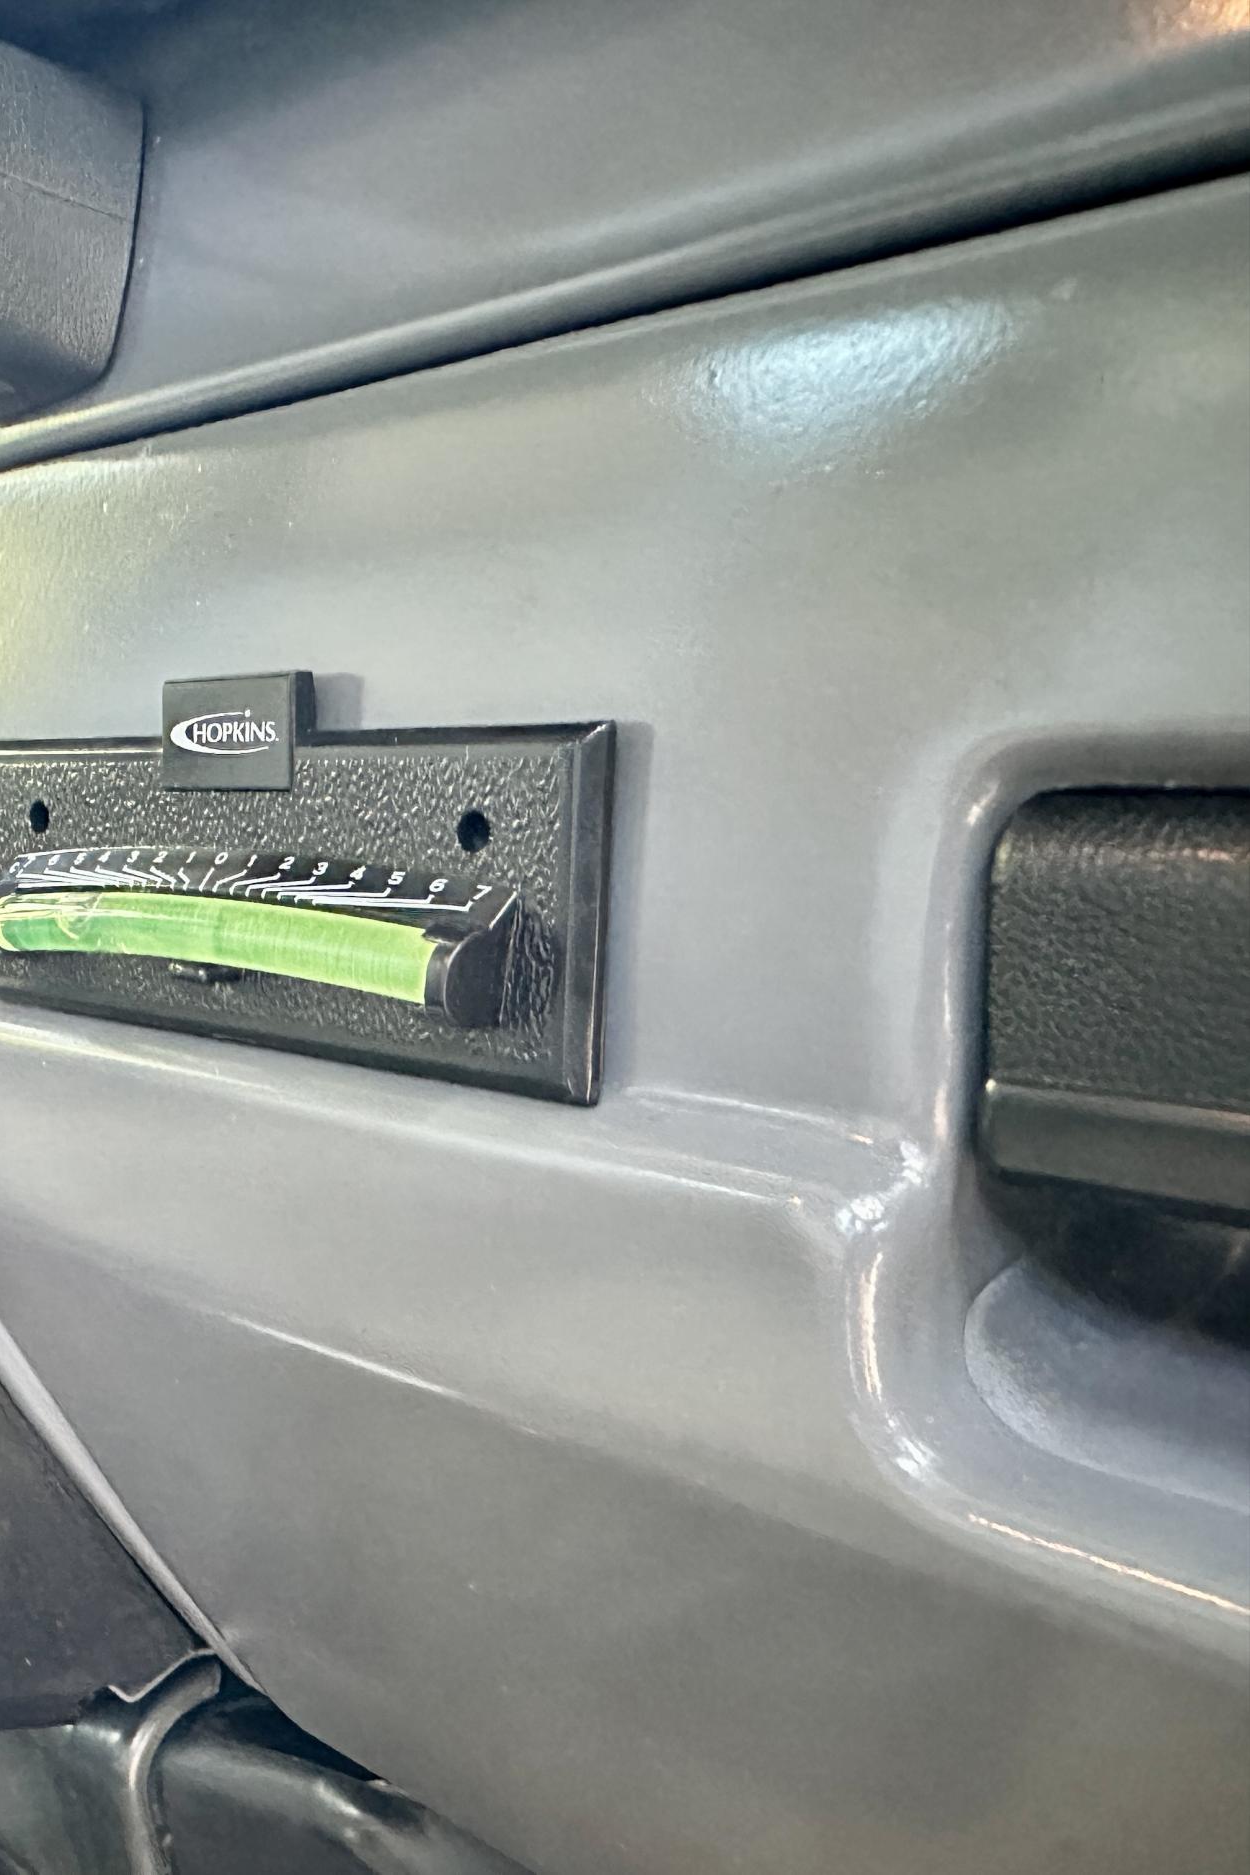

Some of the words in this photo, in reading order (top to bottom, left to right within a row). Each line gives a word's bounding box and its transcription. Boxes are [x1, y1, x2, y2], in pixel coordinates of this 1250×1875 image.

[126, 850, 140, 863] 3
[152, 851, 168, 863] 2
[186, 851, 197, 864] 1
[214, 851, 228, 865] 0
[247, 854, 258, 867] 1
[278, 855, 295, 870] 2
[312, 861, 329, 876] 3
[350, 865, 366, 881] 4
[387, 871, 406, 885] 5
[428, 878, 449, 893] 6
[472, 885, 493, 900] 7
